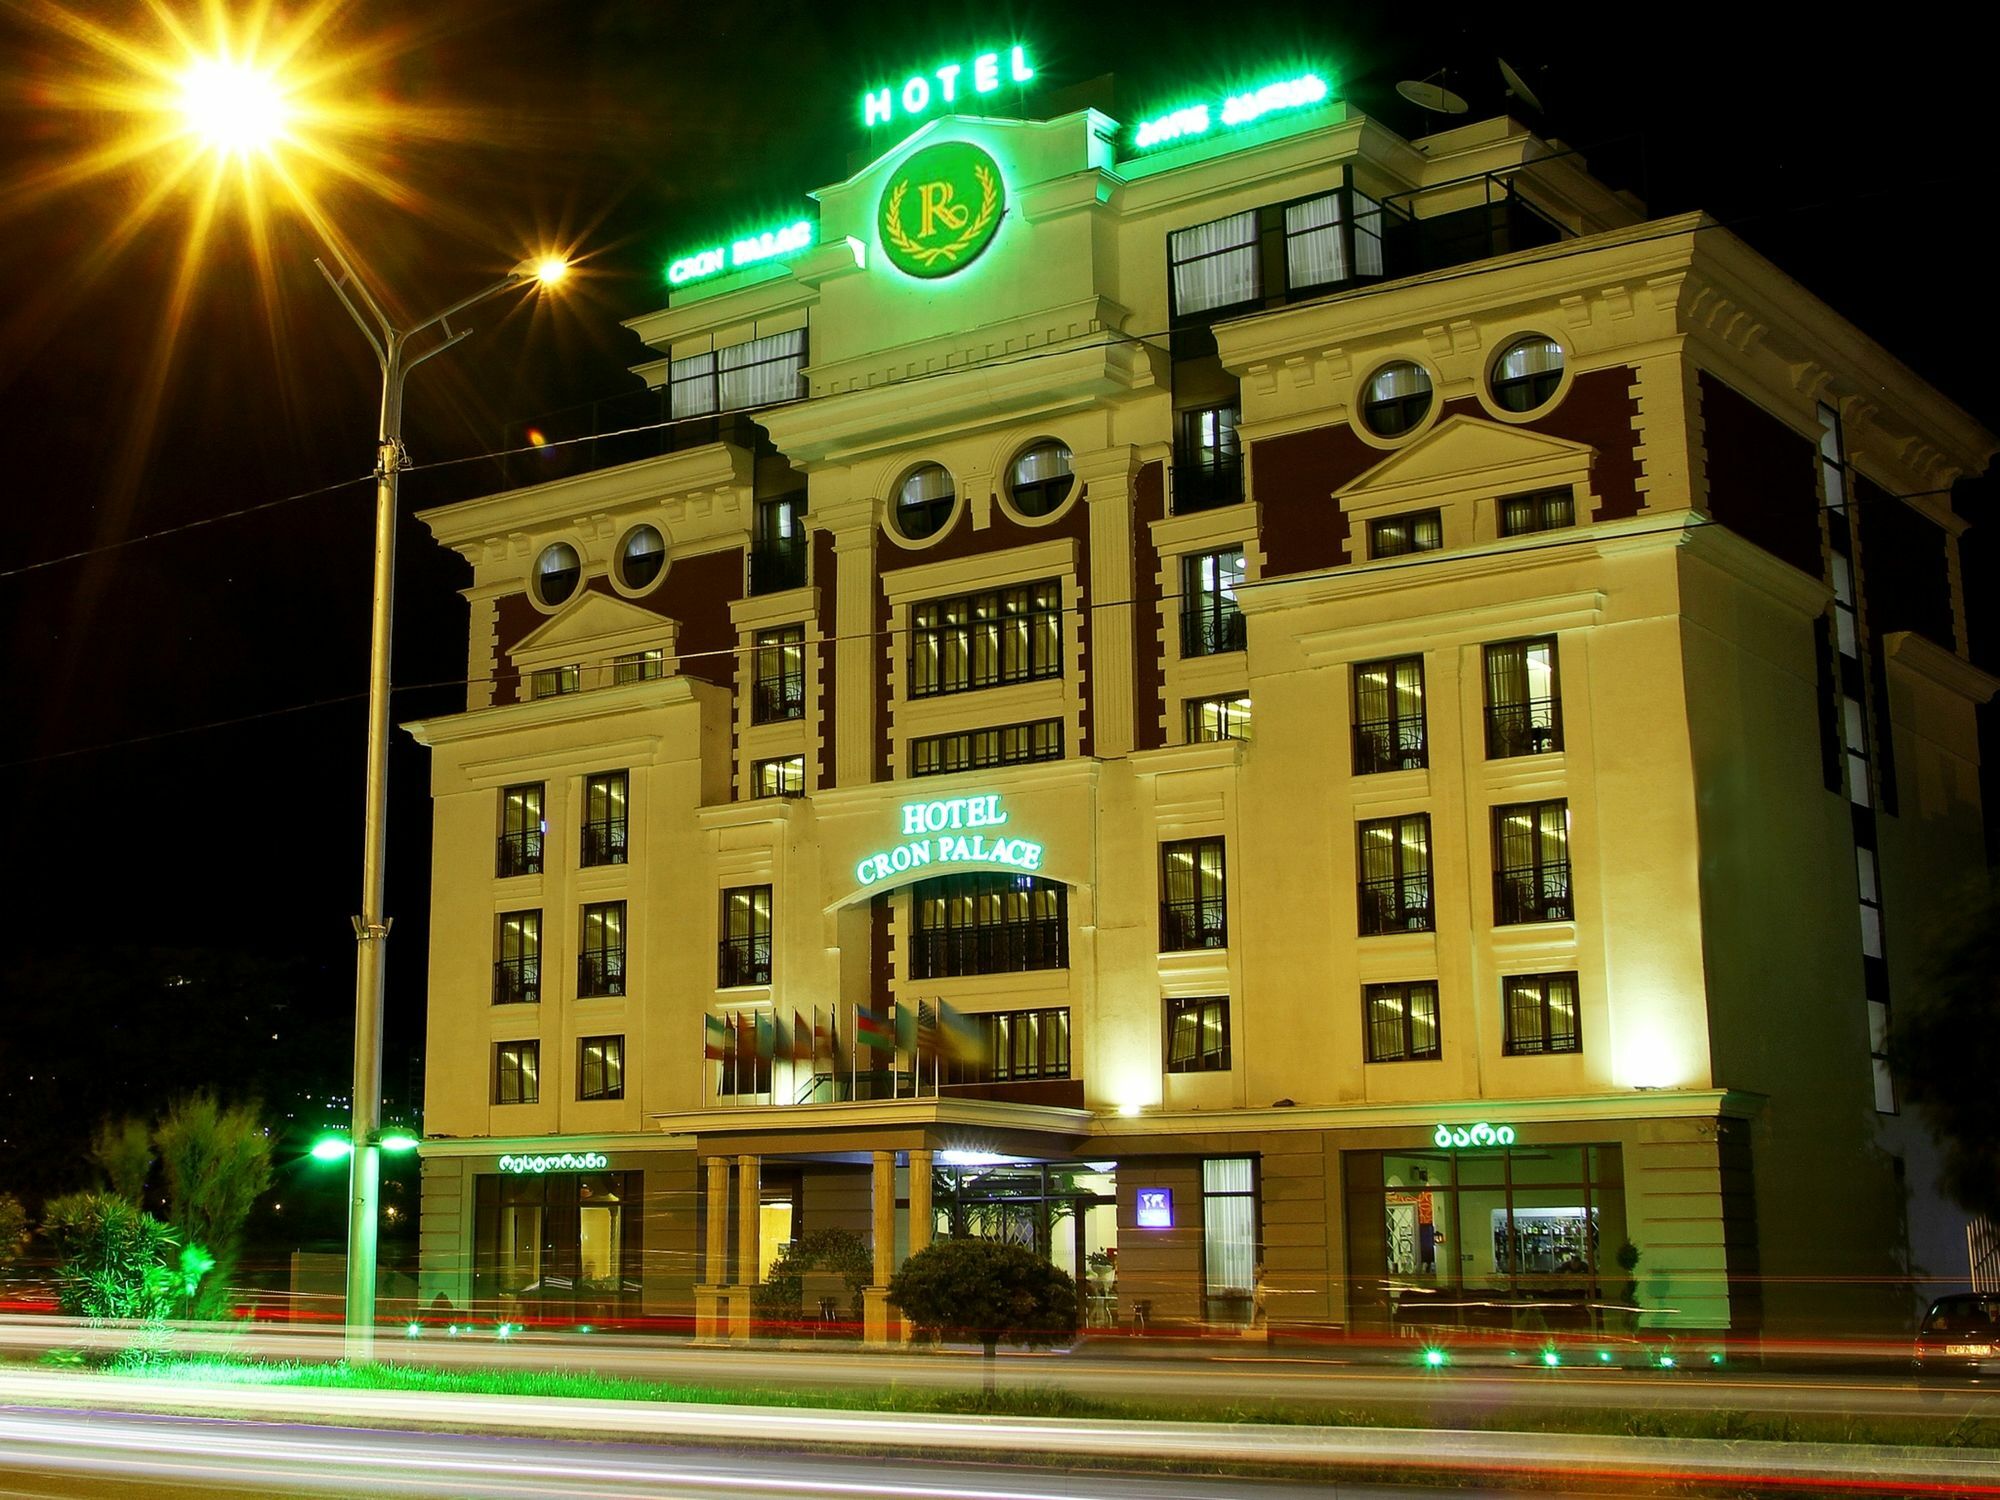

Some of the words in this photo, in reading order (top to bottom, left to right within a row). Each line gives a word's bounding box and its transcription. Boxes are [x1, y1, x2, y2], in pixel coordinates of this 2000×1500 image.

[864, 45, 1034, 127] HOTEL
[902, 794, 1008, 835] HOTEL
[856, 839, 931, 885] CRON
[938, 835, 1042, 870] PALACE
[1434, 1122, 1515, 1148] ბარი
[498, 1152, 608, 1174] რესტორანი
